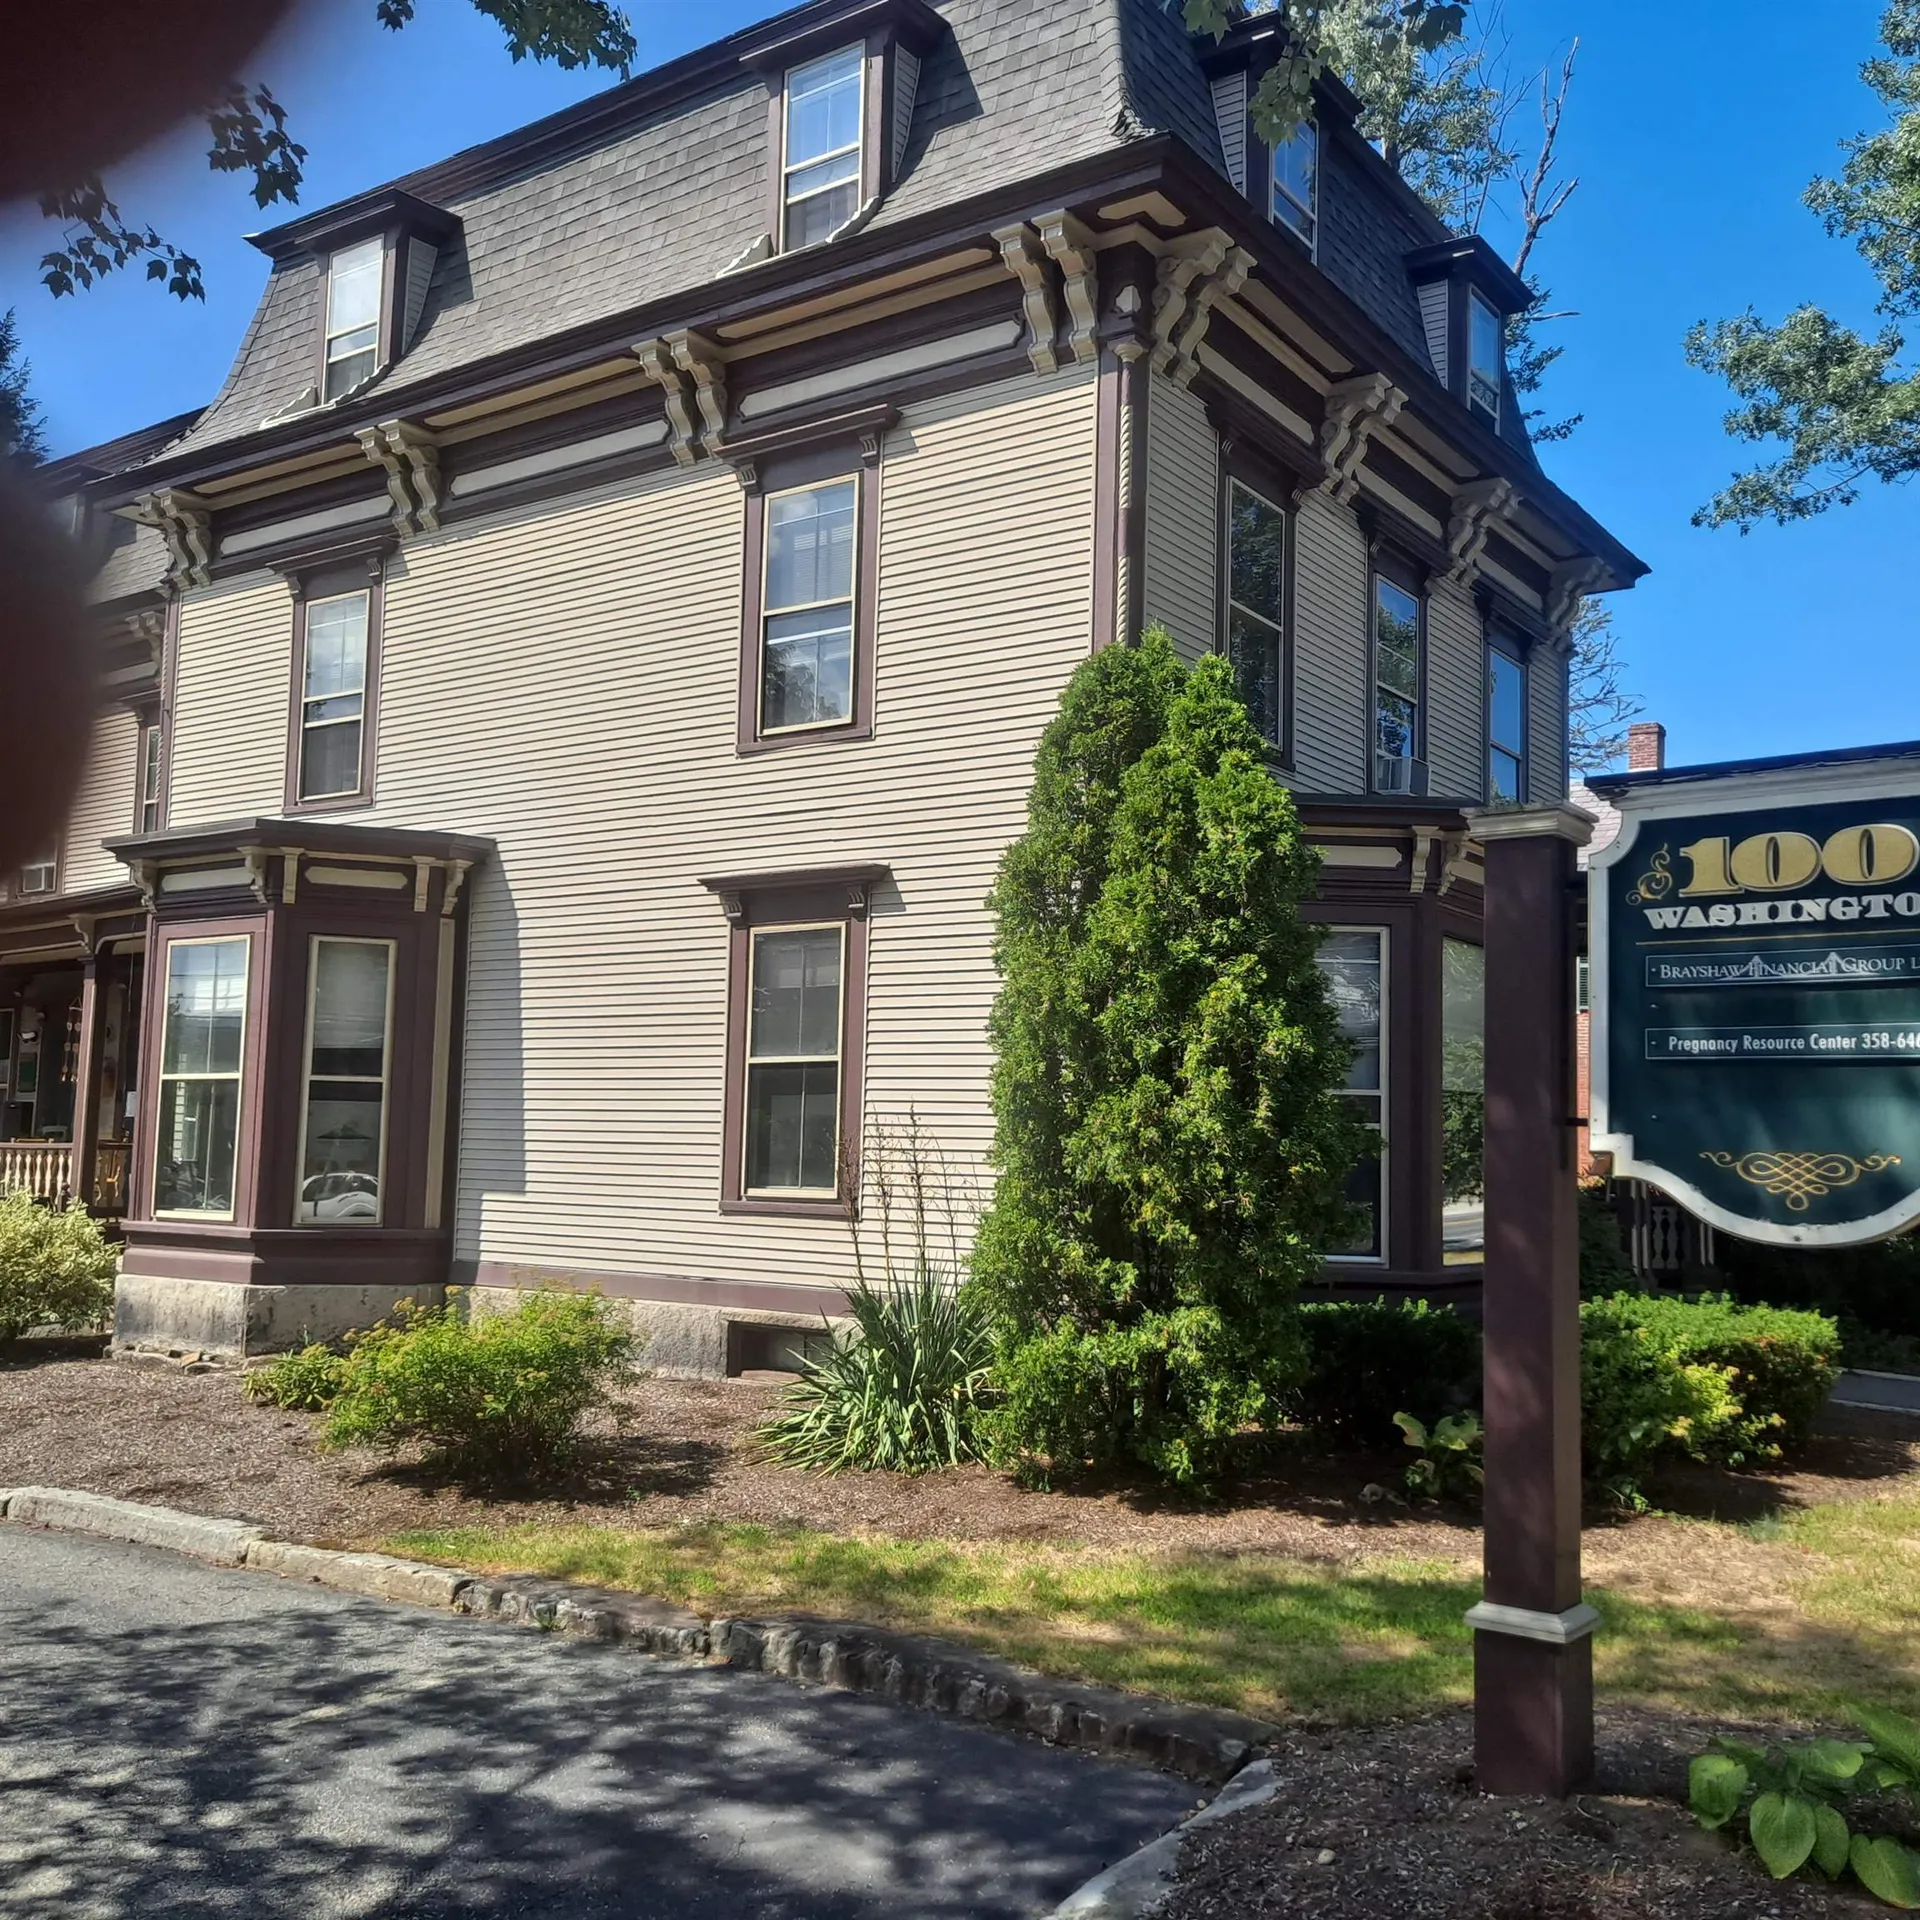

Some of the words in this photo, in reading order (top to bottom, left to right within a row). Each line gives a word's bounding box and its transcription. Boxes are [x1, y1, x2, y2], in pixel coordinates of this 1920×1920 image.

[1679, 824, 1919, 897] 100
[1659, 962, 1744, 979] BRAYSHAW
[1841, 956, 1905, 972] GROUP
[1668, 1035, 1738, 1054] Pregnancy
[1743, 1034, 1805, 1050] Resource
[1809, 1032, 1857, 1049] Center
